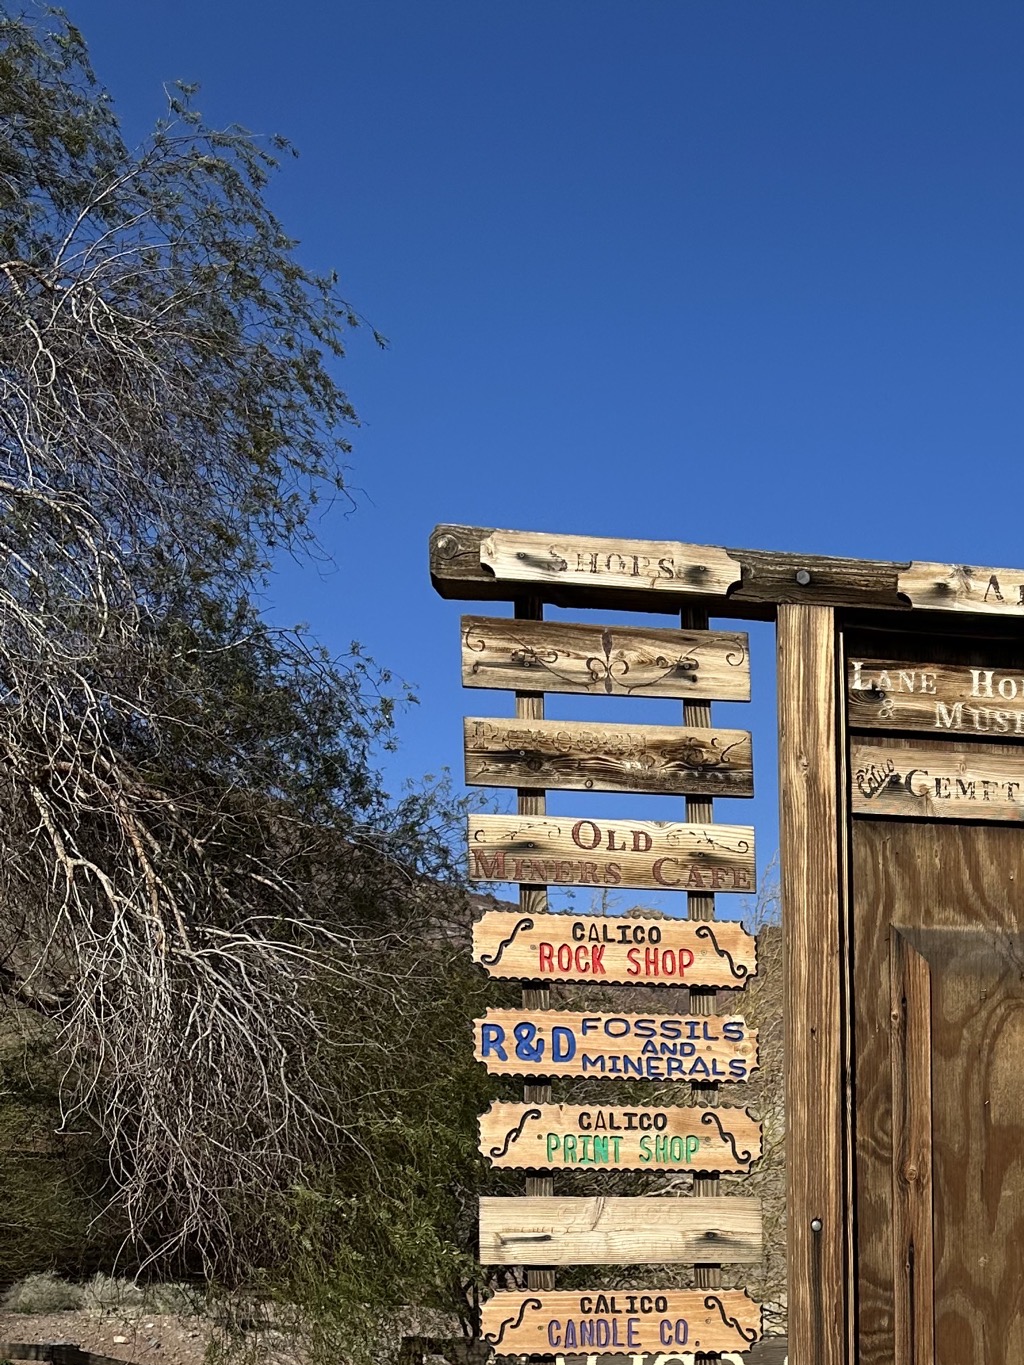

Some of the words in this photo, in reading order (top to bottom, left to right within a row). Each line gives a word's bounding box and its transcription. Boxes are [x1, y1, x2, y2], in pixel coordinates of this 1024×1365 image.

[547, 544, 676, 580] SHOPS
[851, 661, 937, 695] LANE
[878, 699, 895, 718] &
[571, 820, 653, 852] OLD
[471, 849, 622, 885] MINERS
[652, 857, 752, 890] CAFE
[571, 921, 662, 945] CALICO
[538, 941, 607, 976] ROCK
[626, 946, 696, 978] SHOP
[480, 1021, 578, 1064] R&D
[581, 1016, 746, 1042] FOSSILS
[641, 1039, 697, 1057] AND
[581, 1052, 748, 1078] MINERALS
[578, 1111, 668, 1131] CALICO
[546, 1133, 624, 1164] PRINT
[638, 1136, 700, 1165] SHOP
[579, 1294, 668, 1315] CALICO
[547, 1317, 642, 1348] CANDLE
[659, 1319, 700, 1347] CO.
